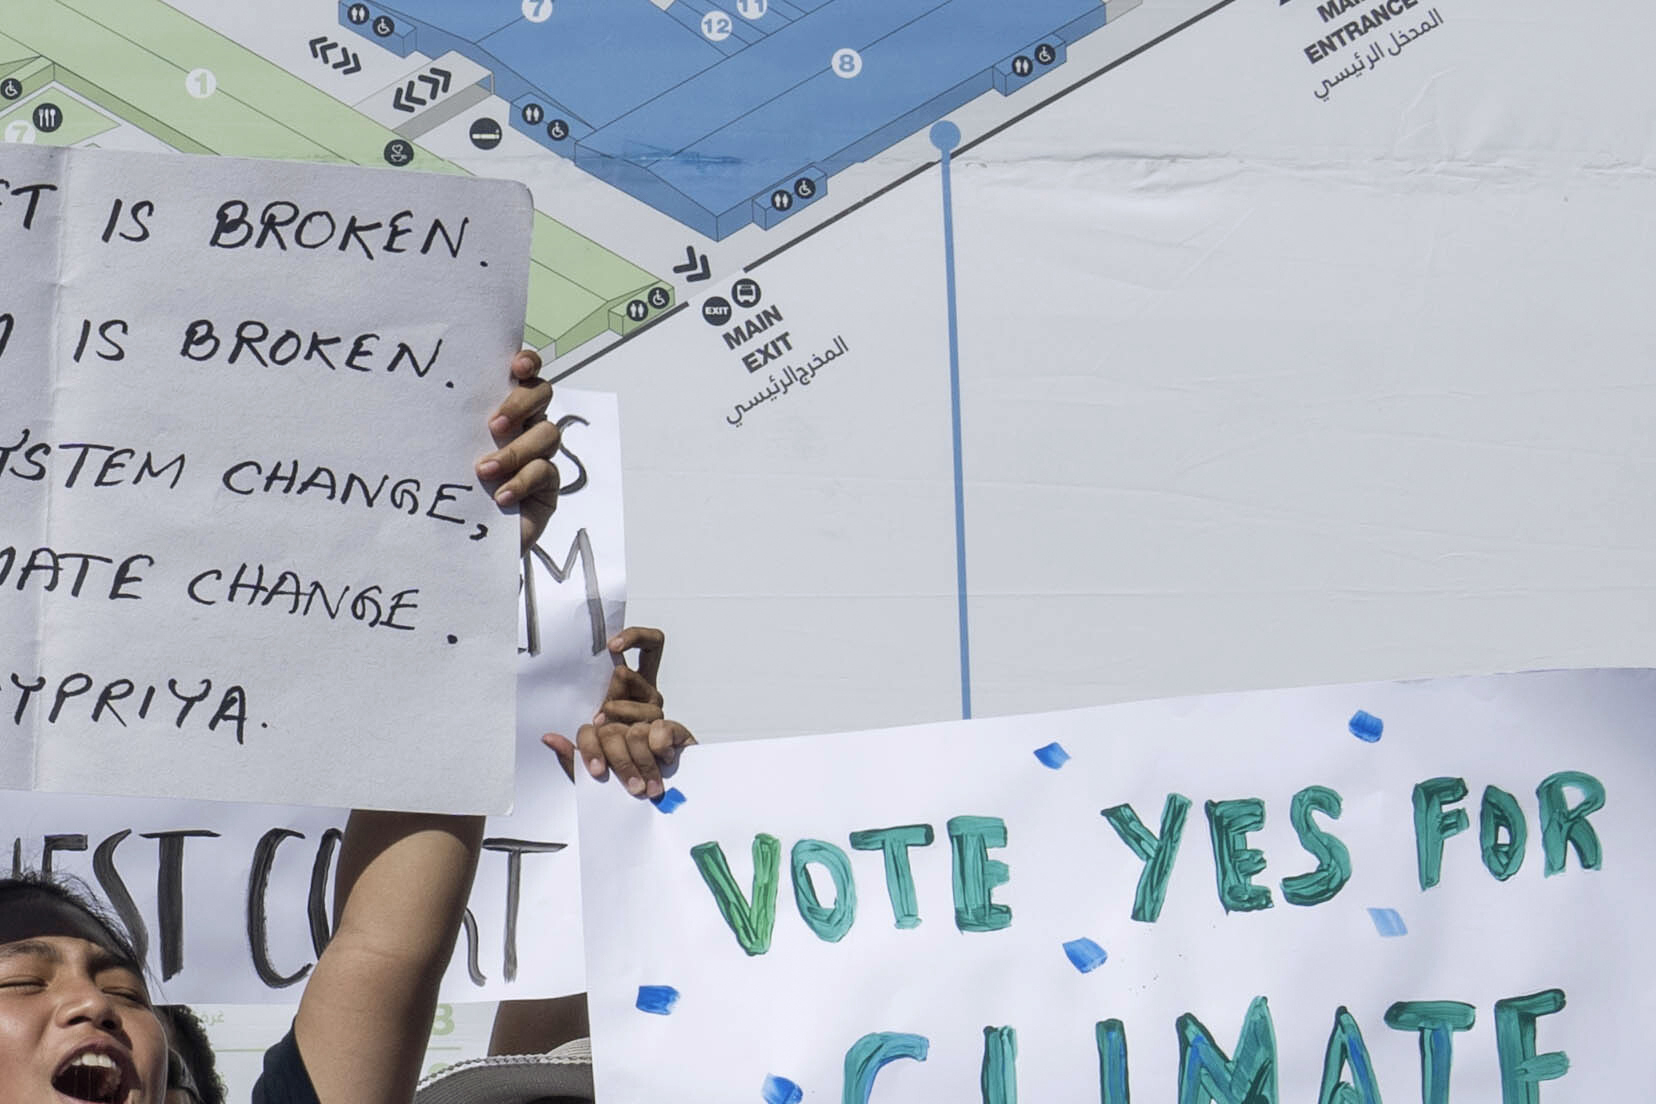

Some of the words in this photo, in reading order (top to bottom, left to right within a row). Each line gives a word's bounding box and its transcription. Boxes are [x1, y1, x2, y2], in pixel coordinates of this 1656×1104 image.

[703, 18, 730, 35] 12
[1304, 0, 1419, 64] ENTRANCE
[1317, 0, 1373, 23] MA
[1387, 8, 1444, 56] المدخل
[1314, 42, 1385, 102] الرئيسي
[101, 198, 154, 244] IS
[210, 199, 489, 268] BROKEN.
[705, 306, 729, 316] EXIT
[722, 304, 784, 351] MAIN
[73, 319, 129, 364] IS
[180, 319, 455, 389] BROKEN.
[742, 331, 793, 374] EXIT
[222, 459, 489, 541] CHANGE,
[187, 562, 459, 645] CHANGE.
[518, 527, 607, 657] M
[690, 814, 1014, 957] VOTE
[1101, 784, 1353, 924] YES
[1413, 770, 1608, 893] FOR
